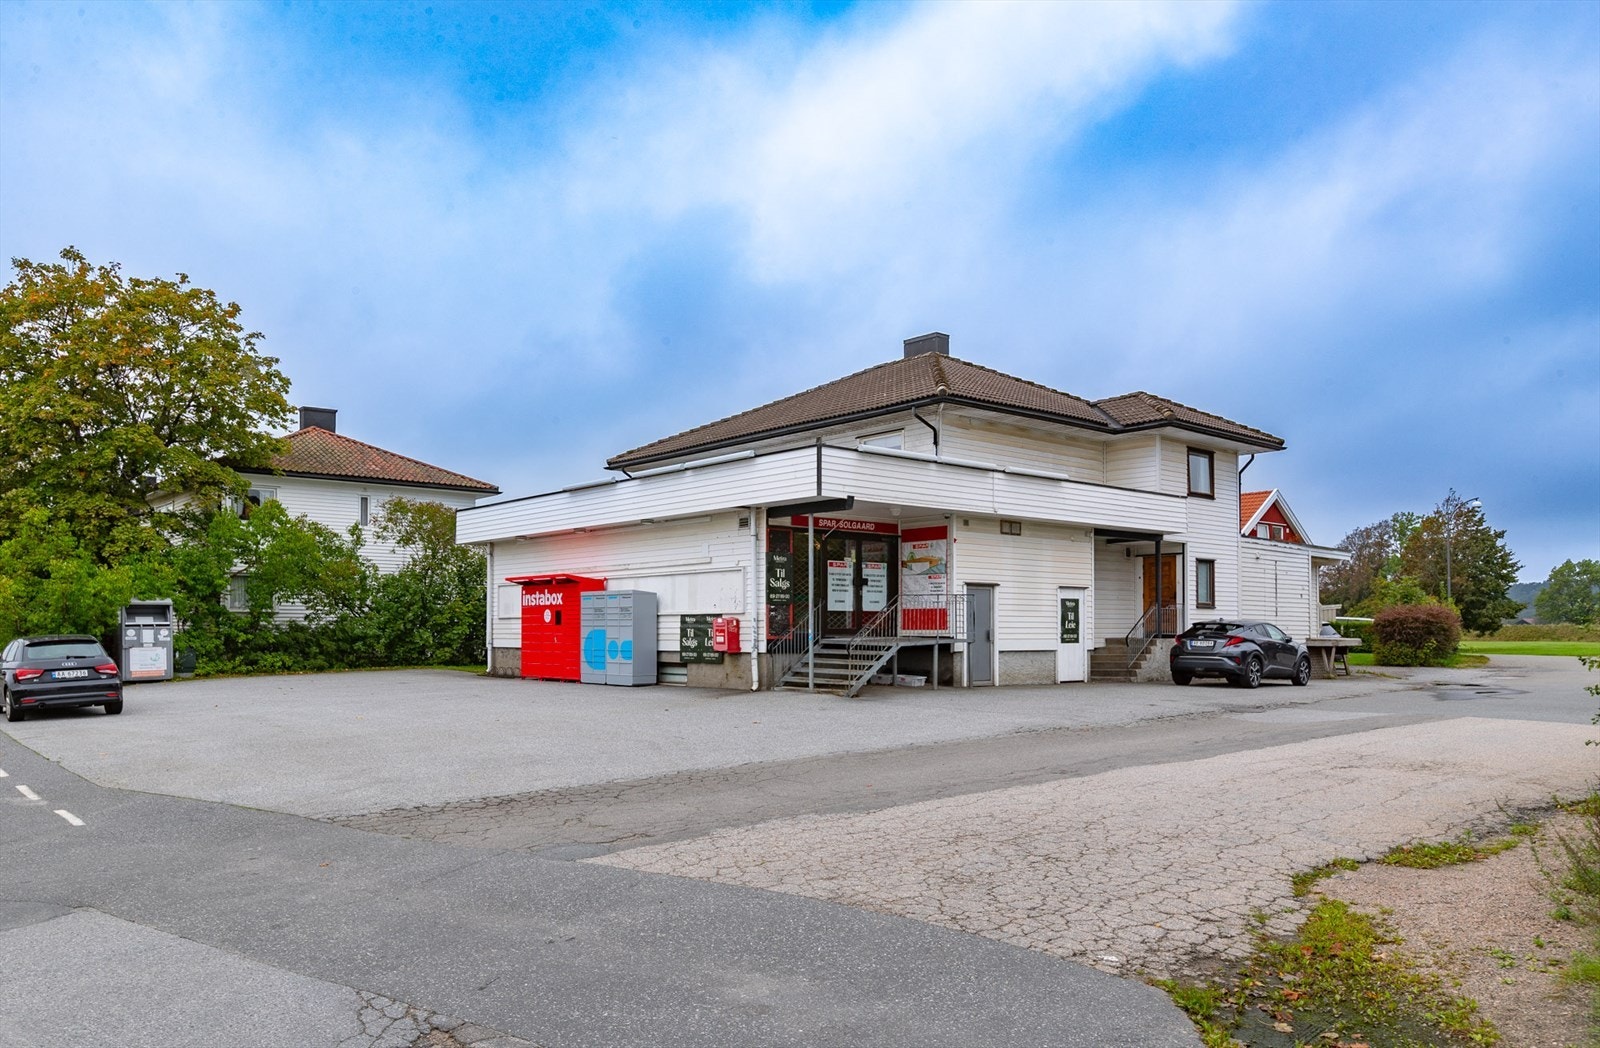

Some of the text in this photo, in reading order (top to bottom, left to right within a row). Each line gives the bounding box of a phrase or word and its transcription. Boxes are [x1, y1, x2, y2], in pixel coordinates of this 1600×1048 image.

[818, 519, 875, 530] SPAR SOLGAARD
[775, 568, 786, 578] Til
[769, 578, 790, 590] Salgs
[522, 589, 563, 606] instabox
[686, 628, 694, 637] Til
[681, 637, 698, 648] Salgs
[704, 638, 713, 646] Lei
